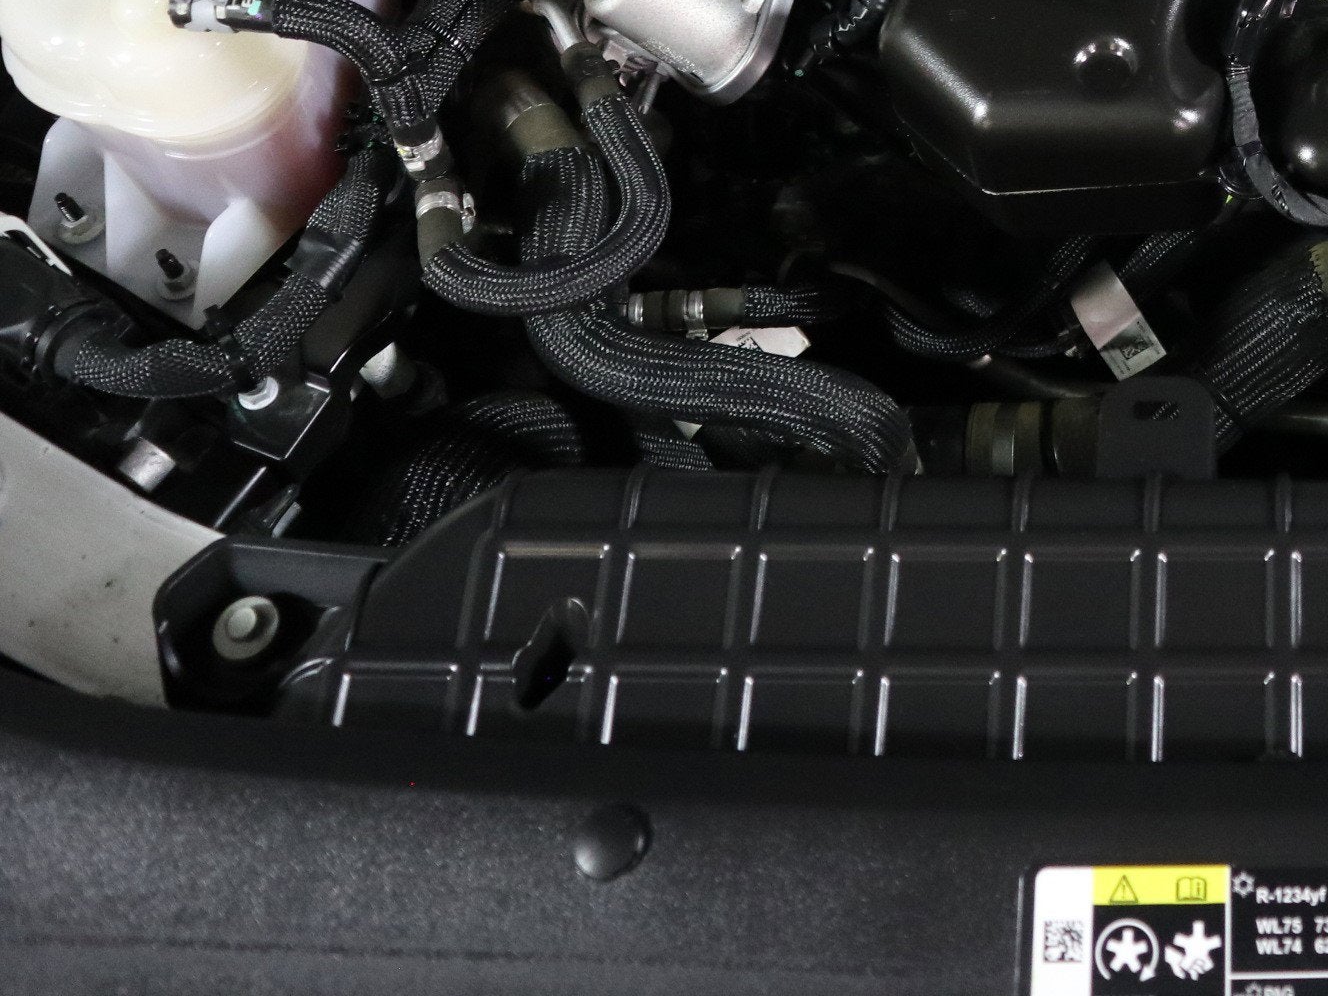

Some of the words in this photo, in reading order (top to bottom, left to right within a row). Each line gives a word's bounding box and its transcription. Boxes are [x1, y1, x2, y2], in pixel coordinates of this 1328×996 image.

[1255, 885, 1328, 907] R-1234yf
[1255, 916, 1303, 935] WL75
[1255, 936, 1303, 955] WL74
